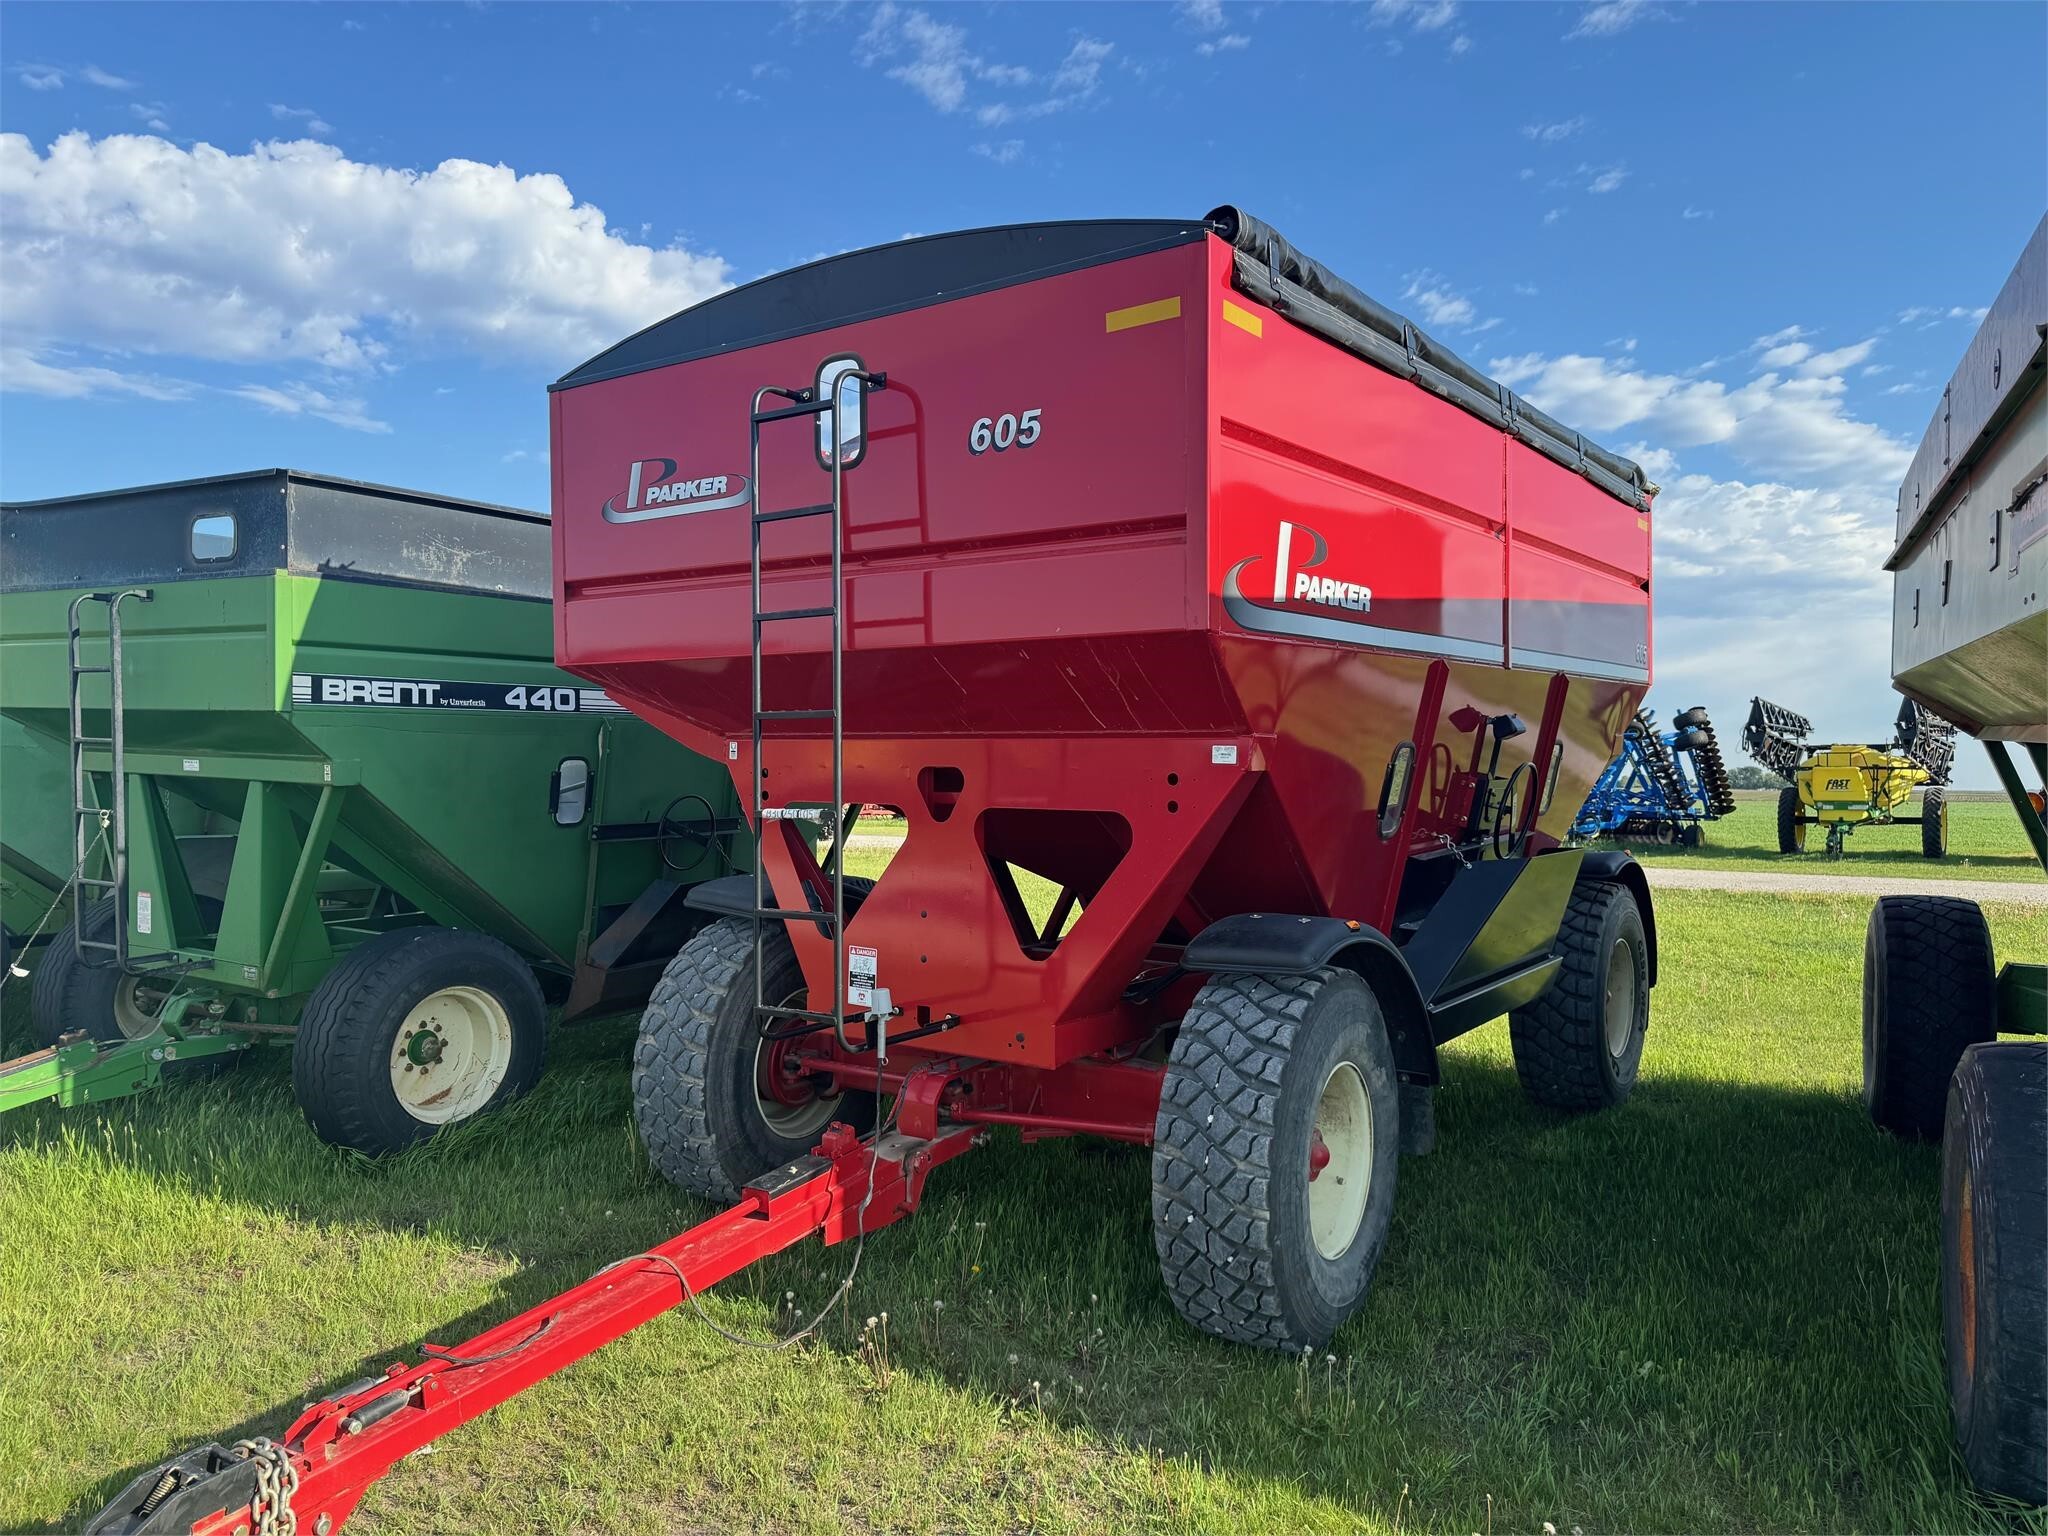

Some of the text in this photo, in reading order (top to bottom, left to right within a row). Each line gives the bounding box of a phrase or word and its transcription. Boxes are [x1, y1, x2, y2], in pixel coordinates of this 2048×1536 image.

[968, 407, 1043, 456] 605
[644, 474, 729, 506] PARKER
[1292, 571, 1373, 613] PARKER
[321, 678, 441, 705] BRENT
[439, 698, 449, 707] by
[504, 686, 577, 711] 440
[1825, 778, 1852, 792] FAST
[856, 948, 877, 957] DANGER
